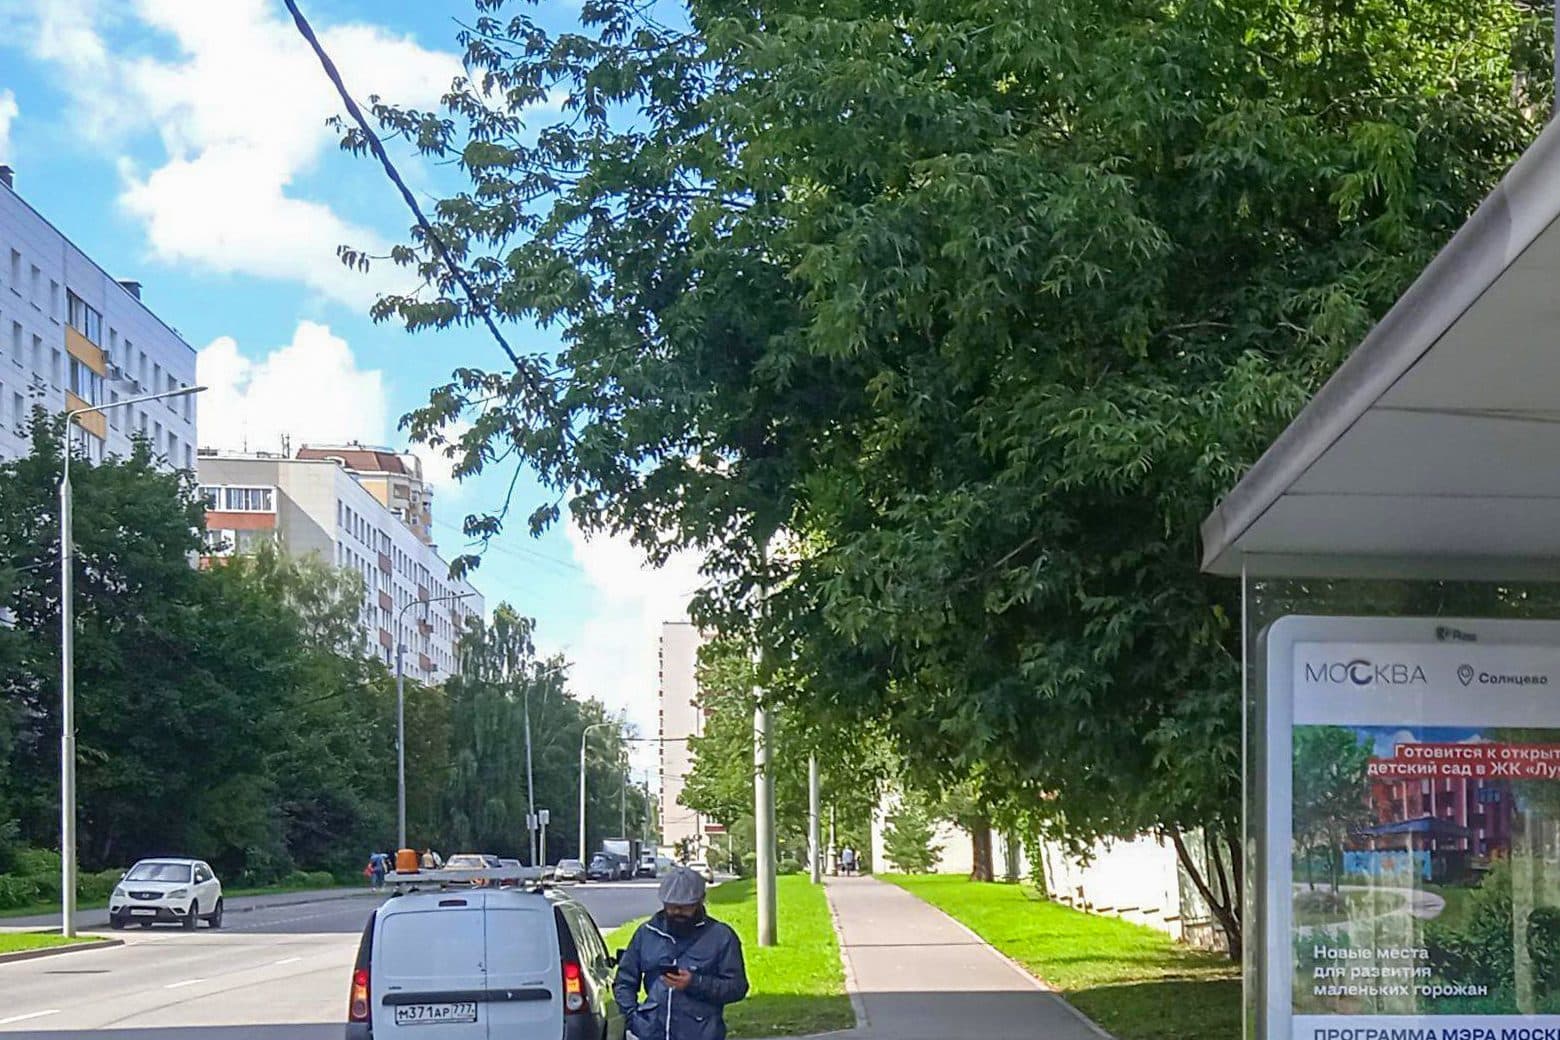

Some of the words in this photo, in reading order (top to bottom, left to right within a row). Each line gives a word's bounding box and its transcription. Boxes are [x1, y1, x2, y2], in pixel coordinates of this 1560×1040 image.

[1305, 659, 1428, 686] МОСКВА
[1479, 672, 1548, 686] Солнцево
[1395, 744, 1483, 759] Готовится
[1487, 748, 1497, 759] к
[1367, 761, 1437, 776] детский
[1441, 764, 1472, 776] сад
[1476, 765, 1486, 775] в
[1490, 762, 1521, 775] ЖК
[1313, 945, 1372, 960] Новые
[1376, 948, 1429, 960] места
[1313, 967, 1346, 978] для
[1350, 967, 1432, 981] развития
[1313, 984, 1409, 997] маленьких
[1413, 984, 1488, 999] горожан
